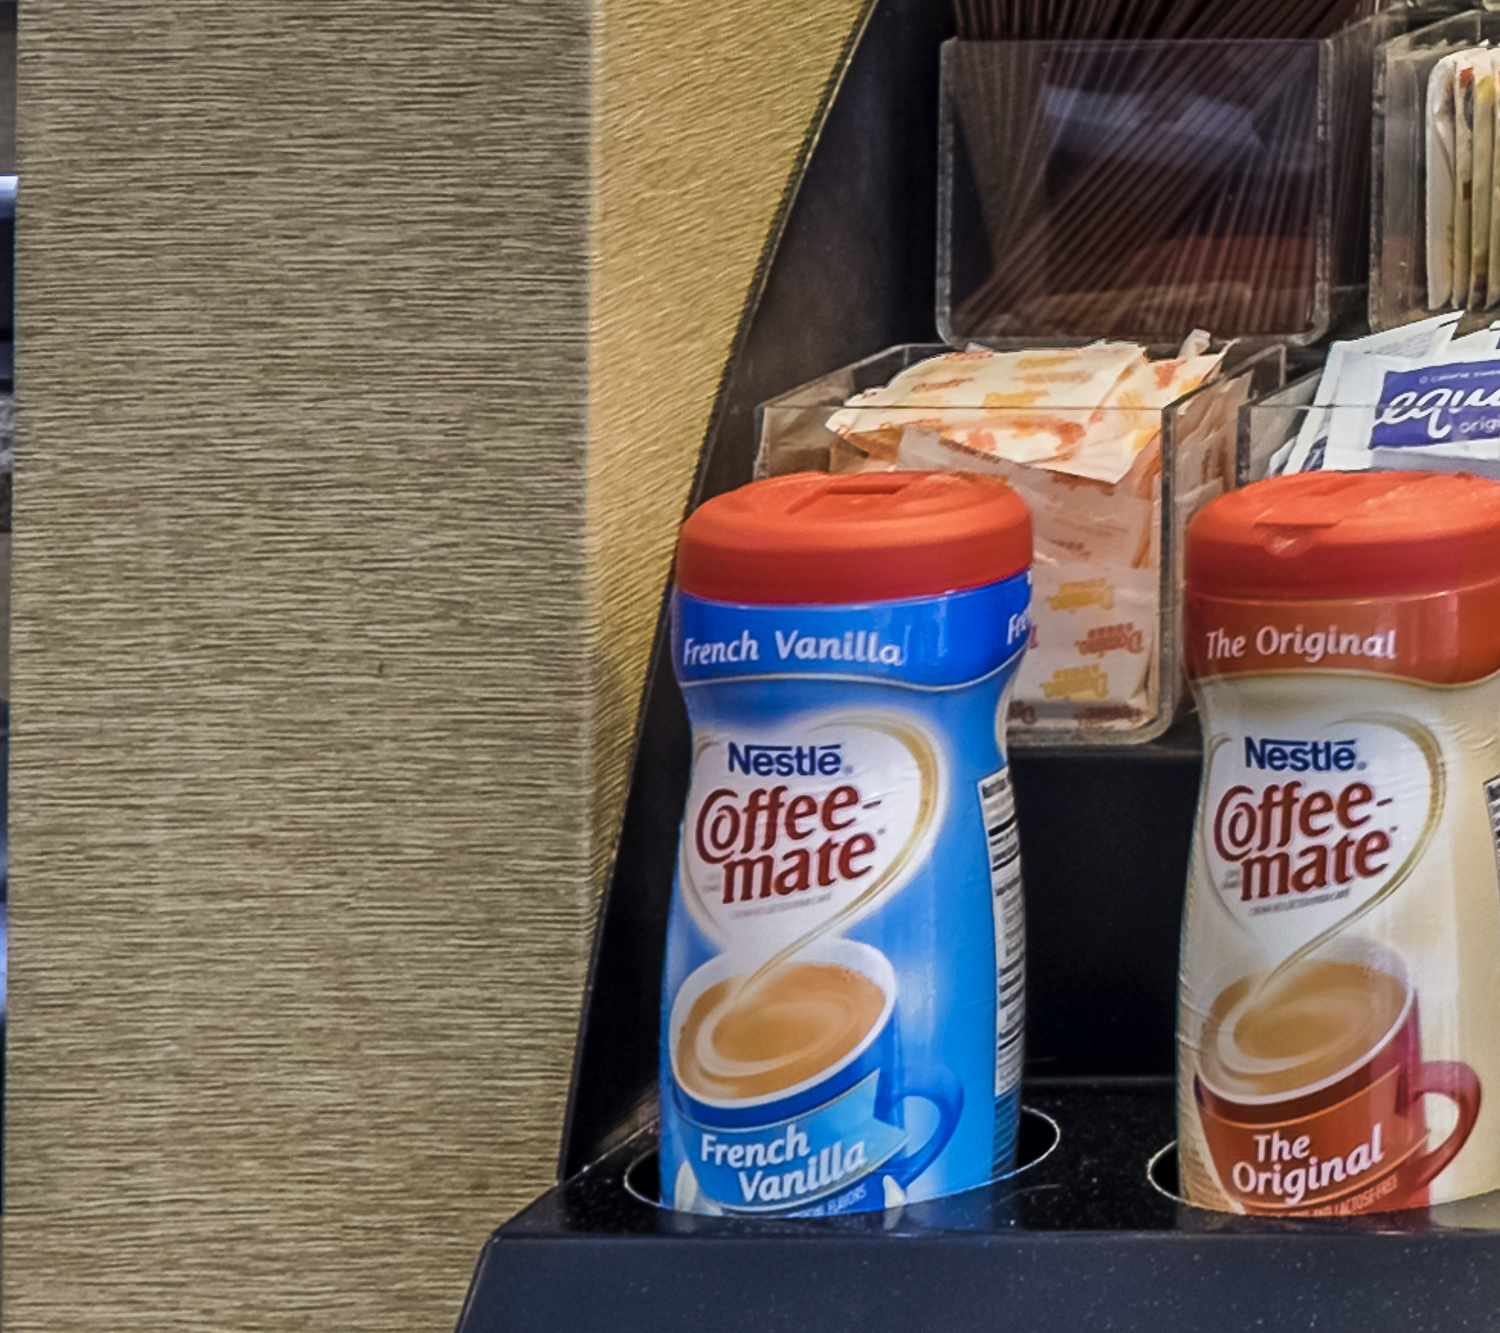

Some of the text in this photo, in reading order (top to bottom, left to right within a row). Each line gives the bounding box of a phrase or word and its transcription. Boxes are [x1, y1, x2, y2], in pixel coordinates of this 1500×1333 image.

[682, 630, 904, 668] French Vanilla
[1205, 625, 1397, 666] The Original
[728, 742, 842, 776] Nestlé
[1244, 736, 1357, 772] Nestlé
[723, 833, 876, 904] mate
[1241, 830, 1391, 901] mate
[701, 1123, 811, 1168] French
[1232, 1121, 1385, 1206] Original
[1253, 1130, 1310, 1162] The
[738, 1141, 868, 1202] Vanilla
